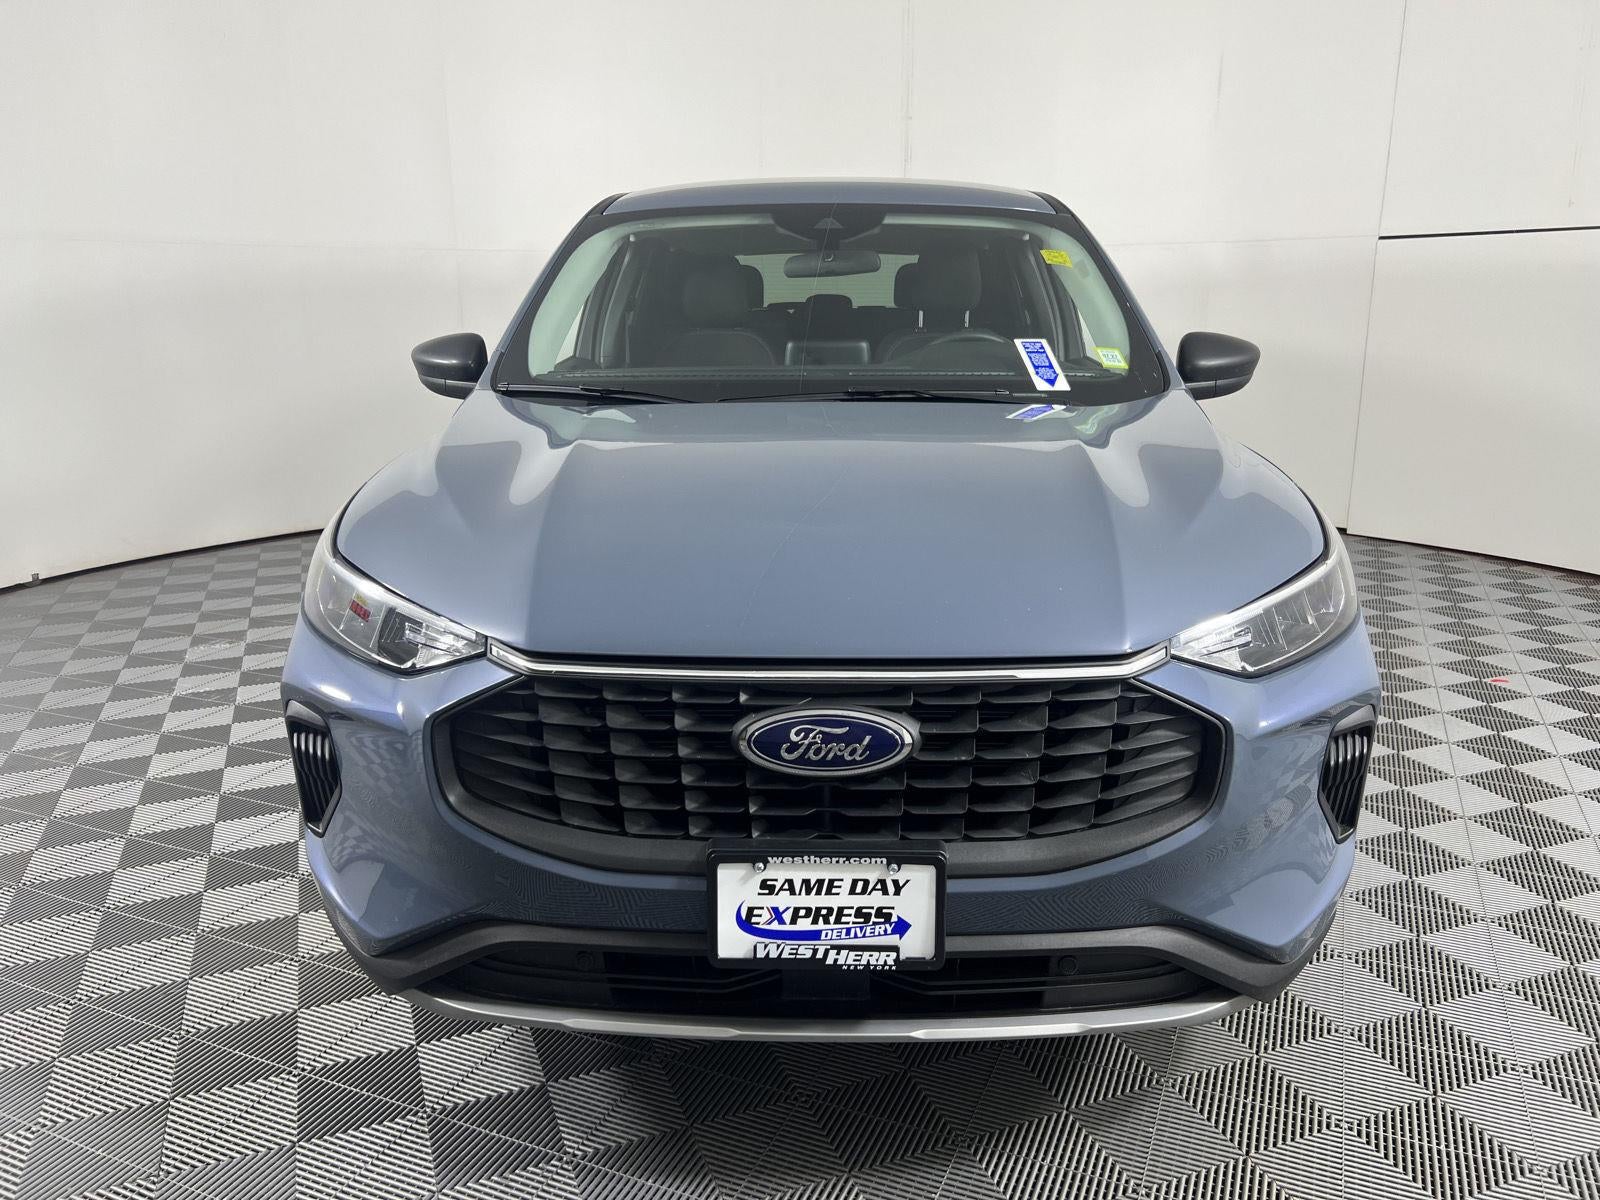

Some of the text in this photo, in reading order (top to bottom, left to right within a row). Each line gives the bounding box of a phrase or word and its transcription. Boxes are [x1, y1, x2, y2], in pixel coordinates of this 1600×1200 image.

[780, 725, 872, 761] Ford
[767, 855, 887, 865] westherr.com
[757, 878, 911, 896] SAME DAY
[744, 906, 895, 925] EXPRESS
[820, 923, 896, 941] DELIVERY
